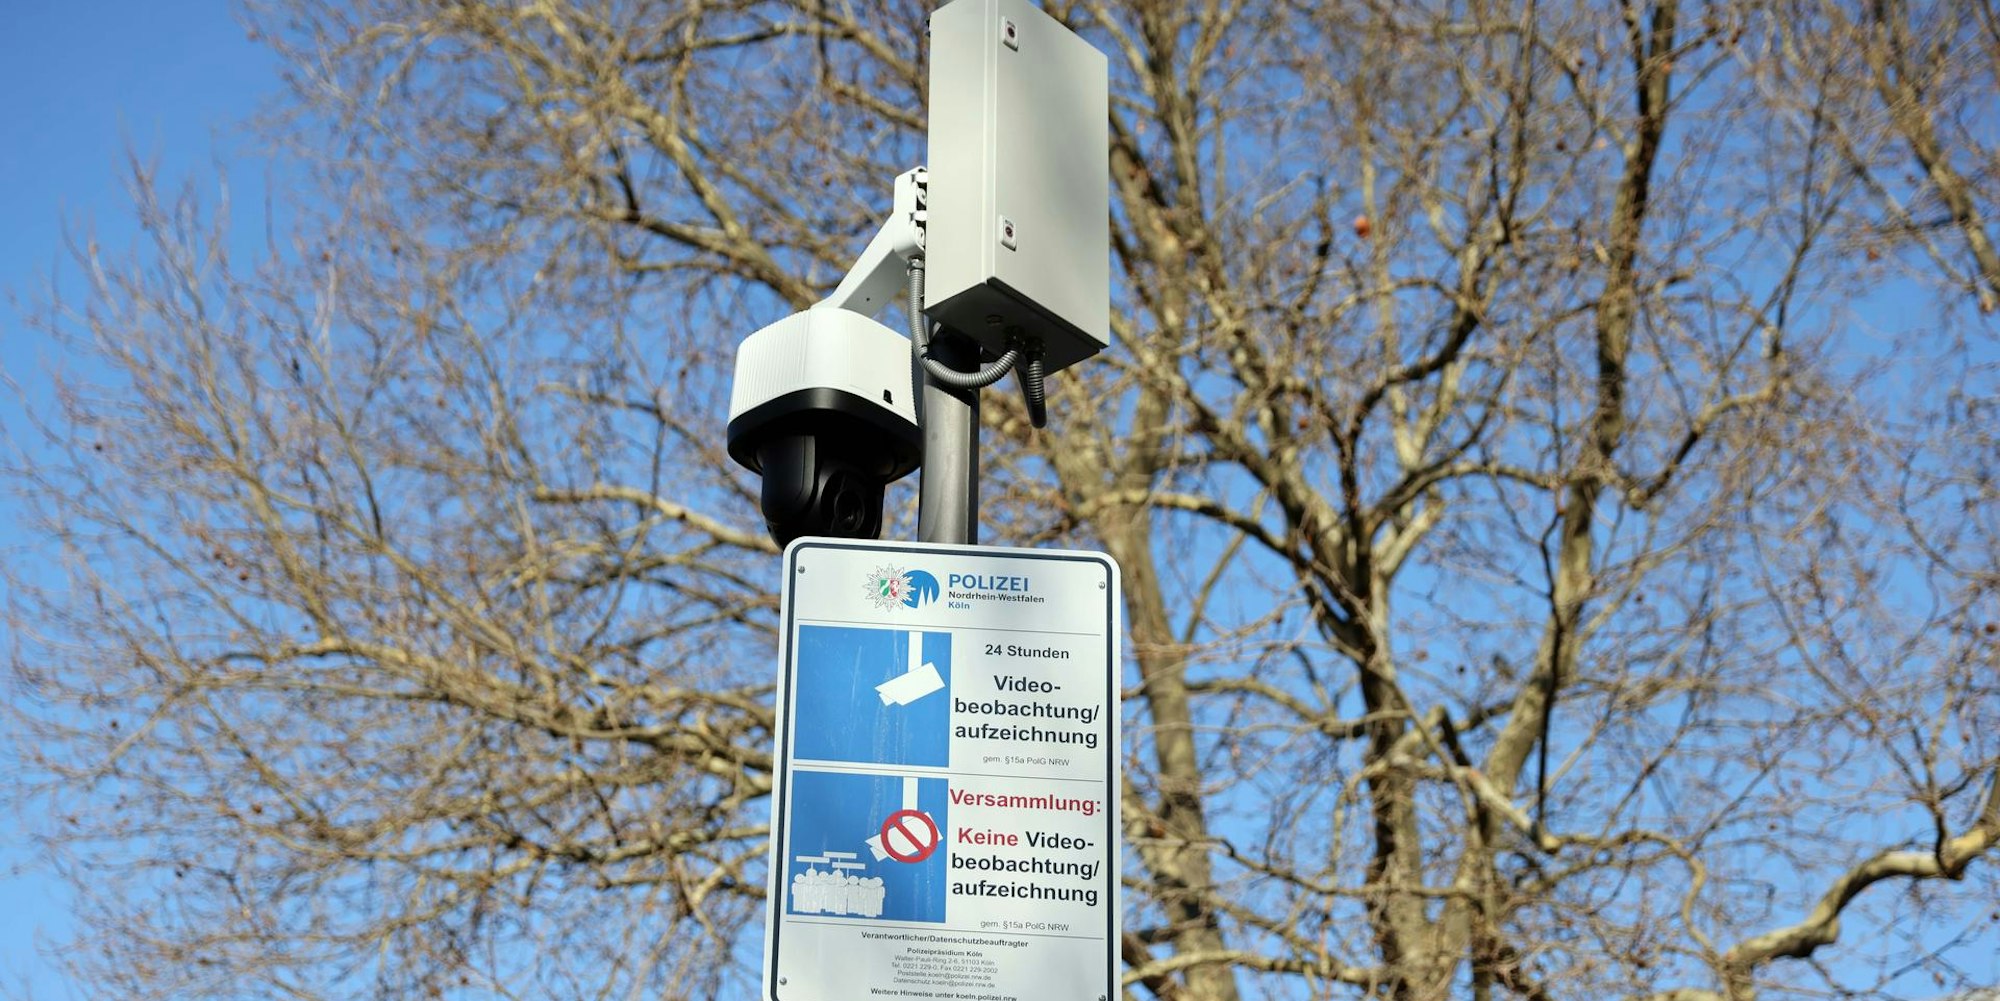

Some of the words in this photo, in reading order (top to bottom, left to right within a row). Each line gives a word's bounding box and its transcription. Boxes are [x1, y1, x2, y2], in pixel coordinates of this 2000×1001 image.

[949, 574, 1029, 592] POLIZEI
[948, 591, 1045, 604] Nordrhein-Westfalen
[948, 601, 970, 610] Köln
[985, 644, 1003, 656] 24
[1007, 645, 1070, 659] Stunden
[994, 675, 1061, 693] Video-
[954, 698, 1099, 723] beobachtung/
[955, 723, 1098, 748] aufzeichnung
[983, 756, 1002, 764] gem.
[1005, 756, 1025, 766] §15a
[1027, 757, 1046, 766] PolG
[1048, 757, 1070, 766] NRW
[949, 788, 1101, 816] Versammlung:
[958, 827, 1019, 847] Keine
[1025, 831, 1094, 850] Video-
[951, 853, 1100, 880] beobachtung/
[952, 880, 1098, 906] aufzeichnung
[980, 921, 1000, 929] gem.
[1003, 920, 1023, 930] §15a
[1025, 921, 1046, 930] PolG
[1048, 922, 1069, 932] NRW
[861, 931, 1029, 949] Verantwortlicher/Datenschutzbeauftragter
[907, 947, 965, 957] Polizeipräsidium
[870, 988, 899, 996] Weitere
[900, 989, 934, 998] Hinweise
